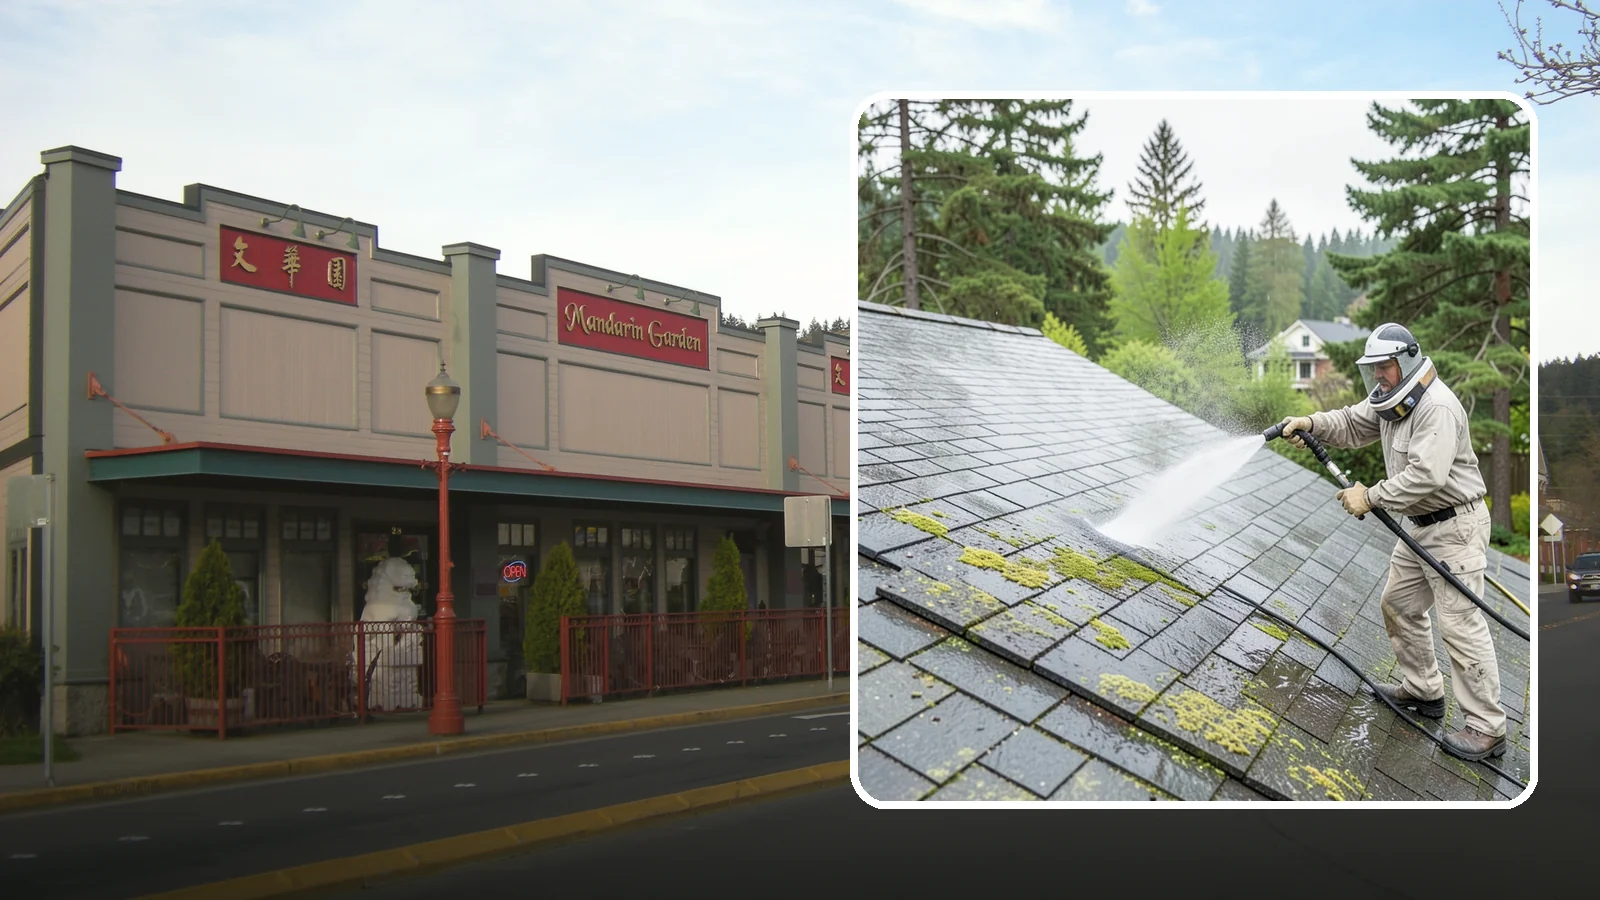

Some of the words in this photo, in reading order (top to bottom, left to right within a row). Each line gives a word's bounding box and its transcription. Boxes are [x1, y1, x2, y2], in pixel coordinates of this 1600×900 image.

[231, 235, 346, 291] 文華園
[564, 302, 644, 341] Mandarin
[648, 320, 702, 352] Garden
[503, 565, 527, 578] OPEN
